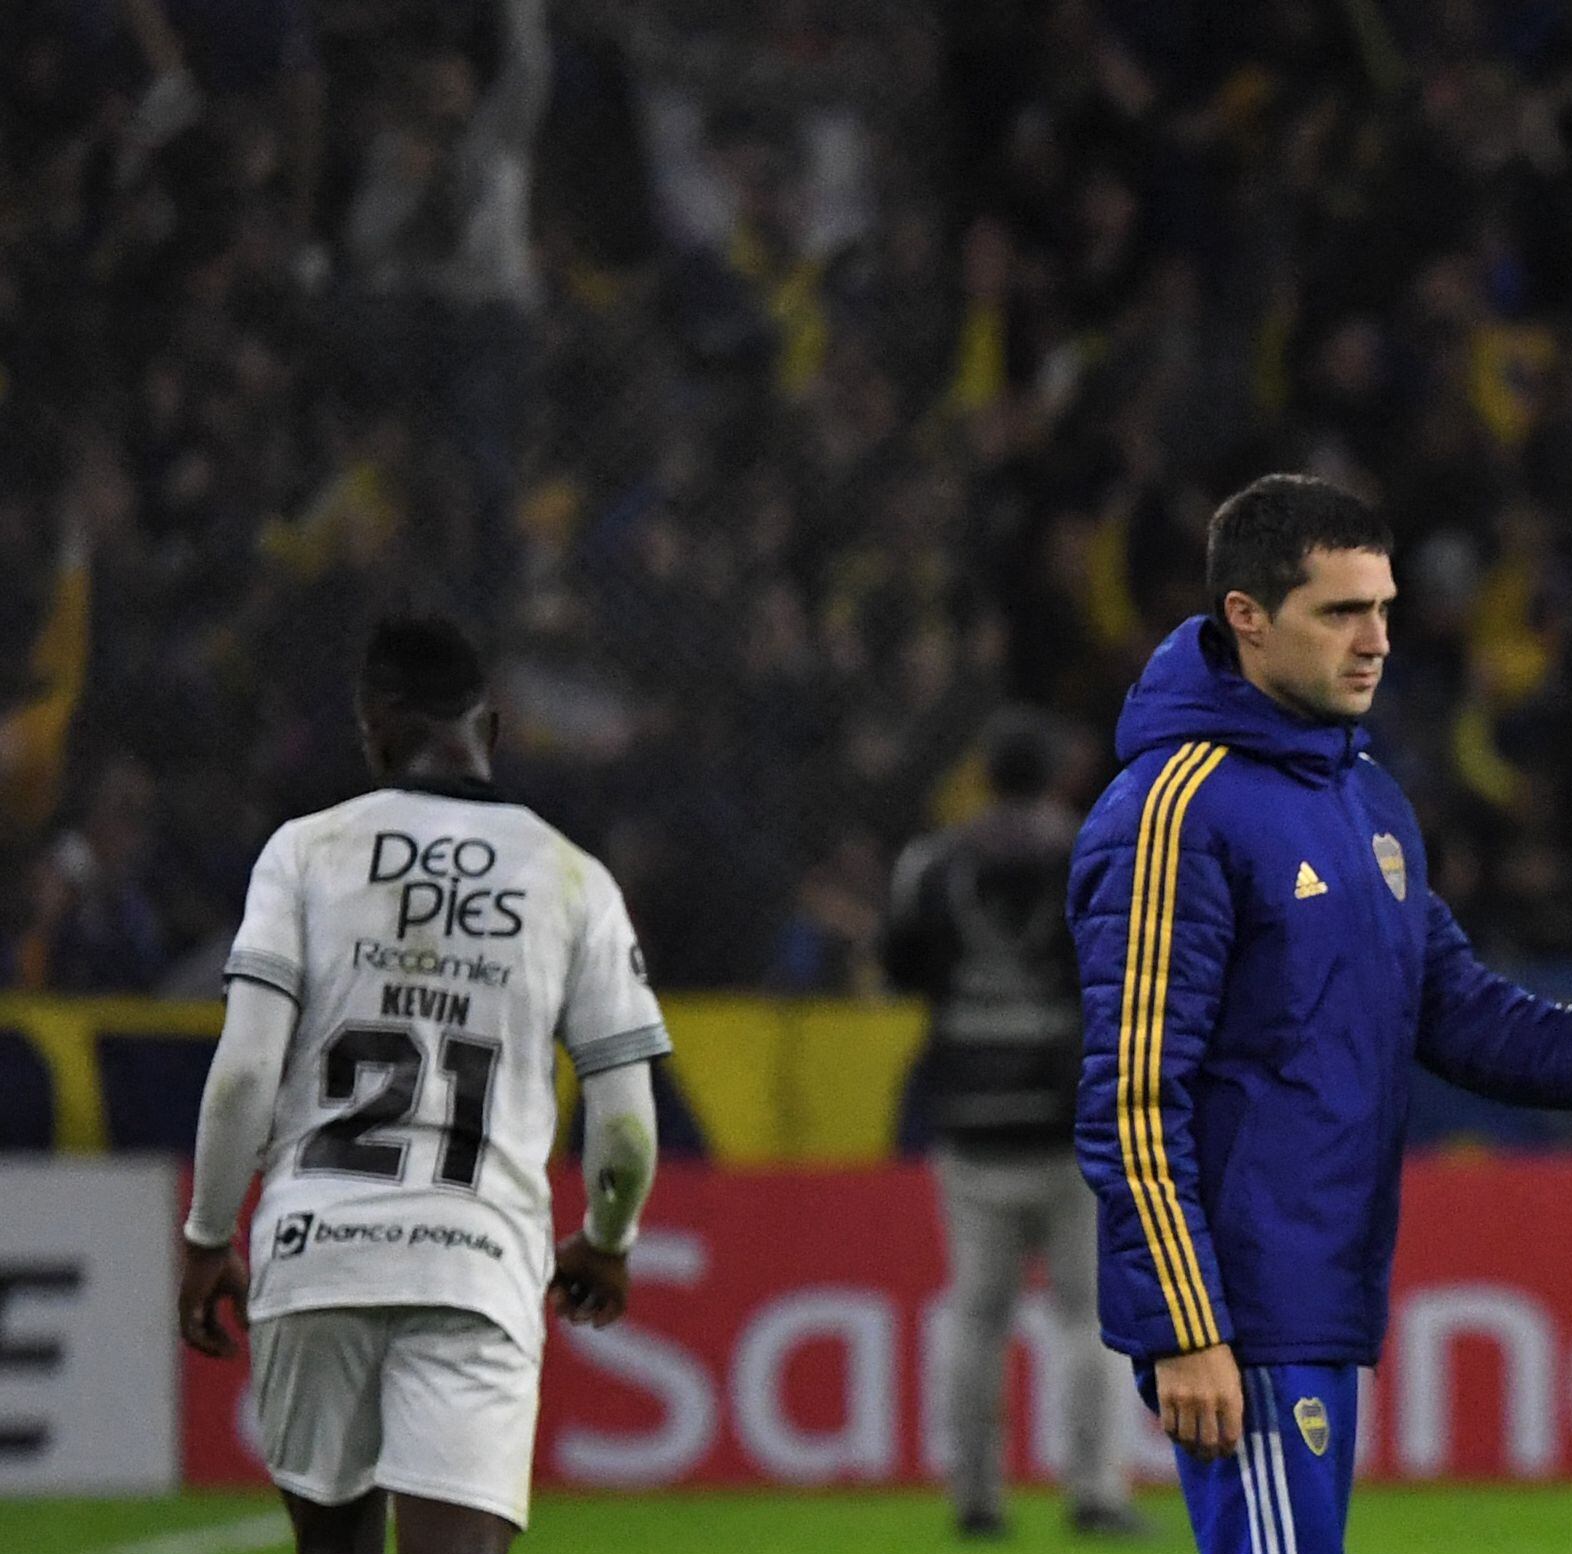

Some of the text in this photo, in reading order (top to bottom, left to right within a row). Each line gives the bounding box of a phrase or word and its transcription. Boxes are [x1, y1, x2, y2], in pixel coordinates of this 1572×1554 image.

[381, 984, 470, 1027] KEVIN
[294, 1018, 501, 1197] 21
[315, 1219, 403, 1244] banco
